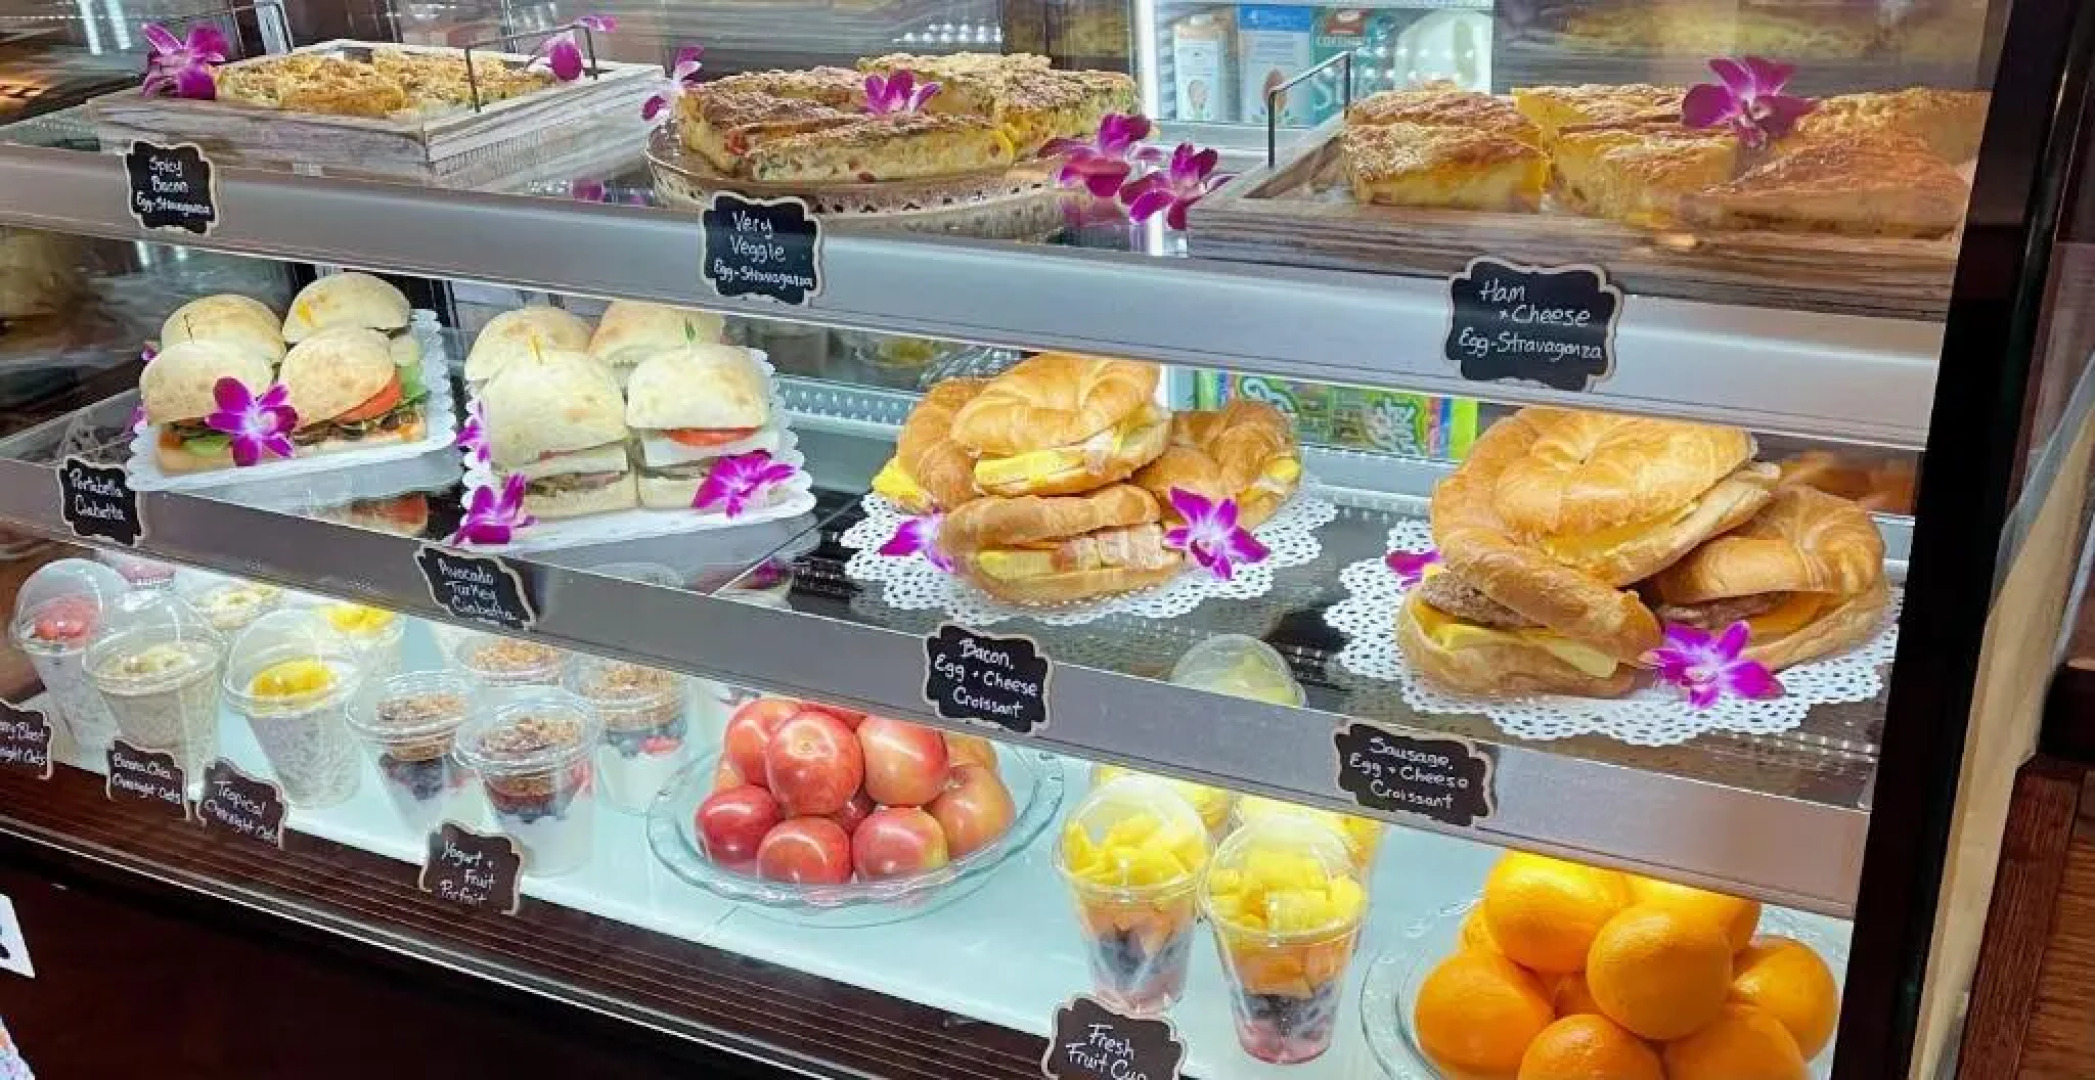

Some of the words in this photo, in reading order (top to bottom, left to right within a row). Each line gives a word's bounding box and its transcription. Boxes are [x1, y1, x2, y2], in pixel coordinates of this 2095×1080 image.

[148, 155, 183, 178] Spicy
[151, 175, 189, 193] Bacon
[732, 210, 773, 240] Very
[730, 235, 786, 263] Veggie
[1479, 277, 1526, 303] Ham
[1511, 304, 1591, 328] Cheese
[1458, 326, 1603, 363] Egg-Stravaganza
[75, 494, 126, 522] Ciabatta
[437, 557, 494, 586] Avocado
[443, 580, 498, 612] Turkey
[958, 638, 1015, 671] Bacon,
[934, 652, 965, 682] Egg
[983, 671, 1038, 697] Cheese
[952, 686, 1024, 719] Croissant
[1349, 752, 1382, 779] Egg
[1400, 765, 1470, 790] Cheese
[212, 780, 267, 818] Tropical
[1369, 779, 1454, 809] Croissant
[441, 839, 482, 868] Yogurt
[440, 878, 488, 908] Parfait
[465, 868, 496, 891] Fruit
[1065, 1042, 1108, 1073] Fruit
[1087, 1024, 1135, 1061] Fresh
